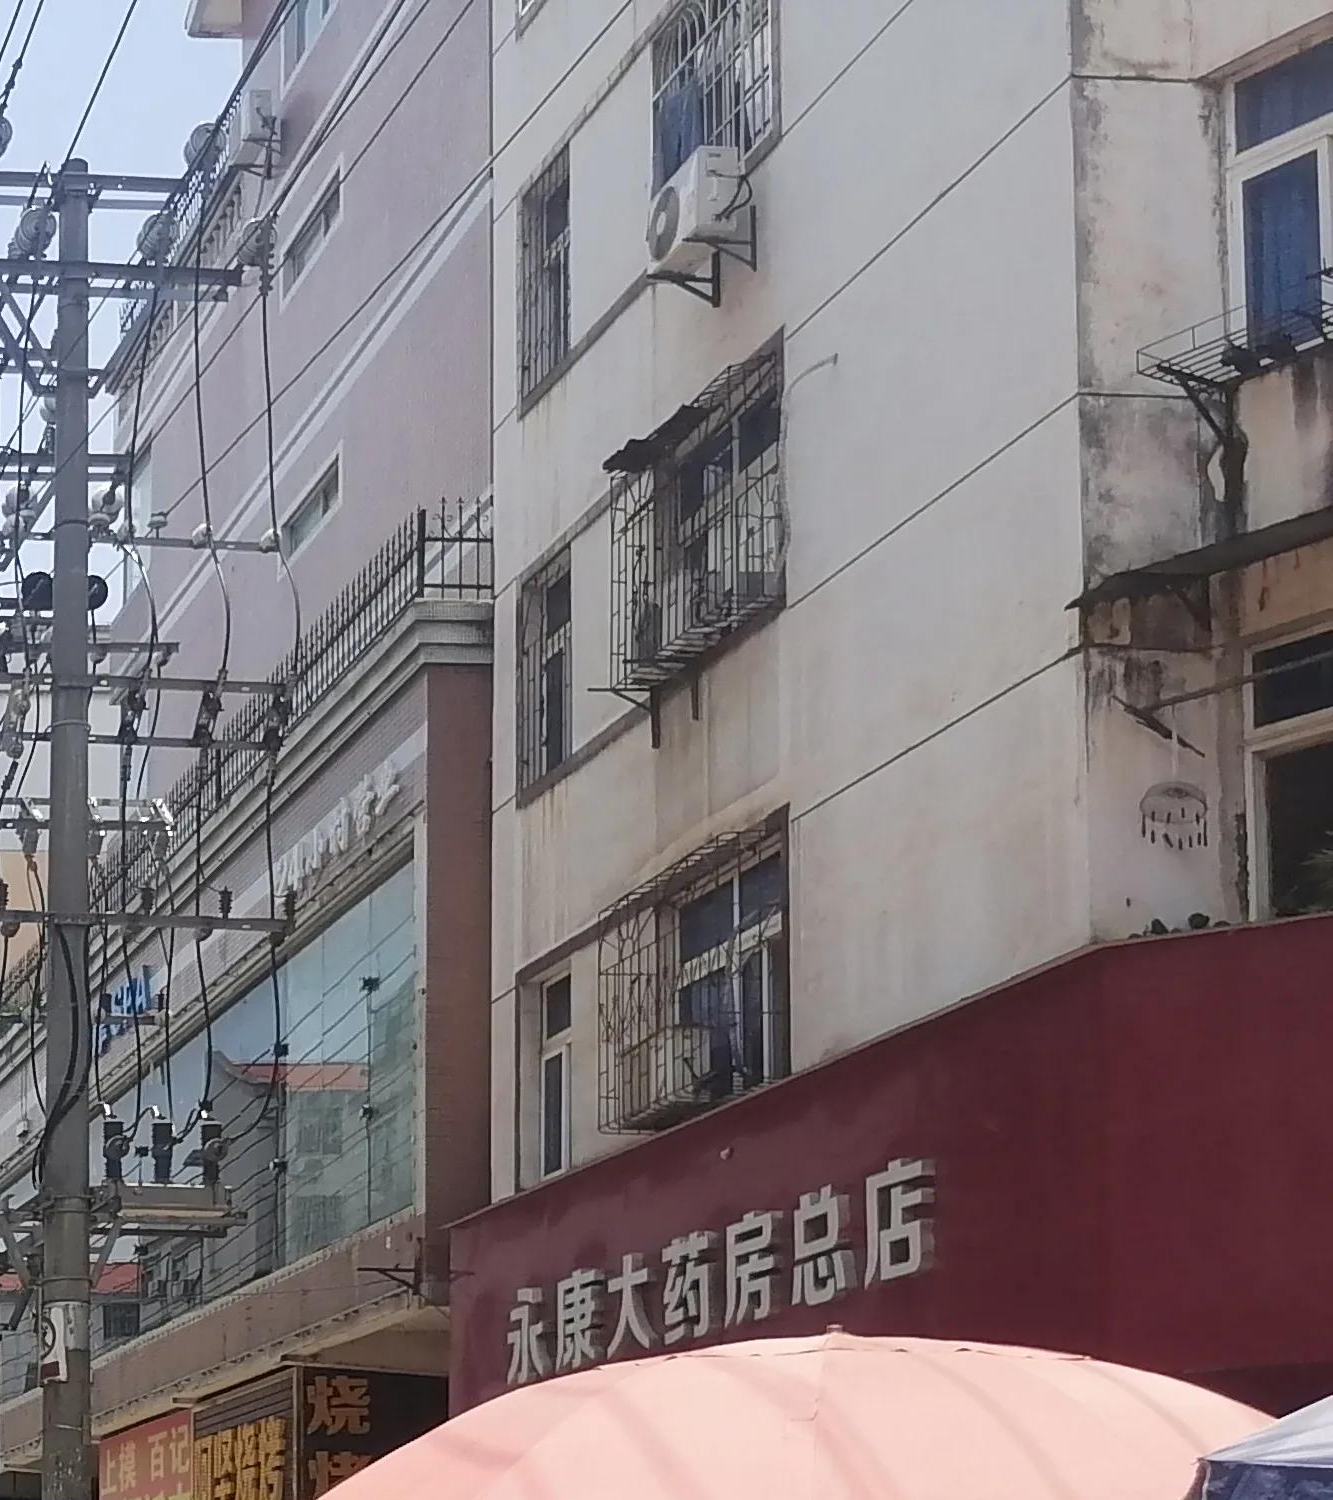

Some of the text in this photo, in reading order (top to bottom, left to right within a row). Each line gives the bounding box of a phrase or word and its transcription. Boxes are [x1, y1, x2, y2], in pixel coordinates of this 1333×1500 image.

[506, 1158, 936, 1386] 永康大药房总店
